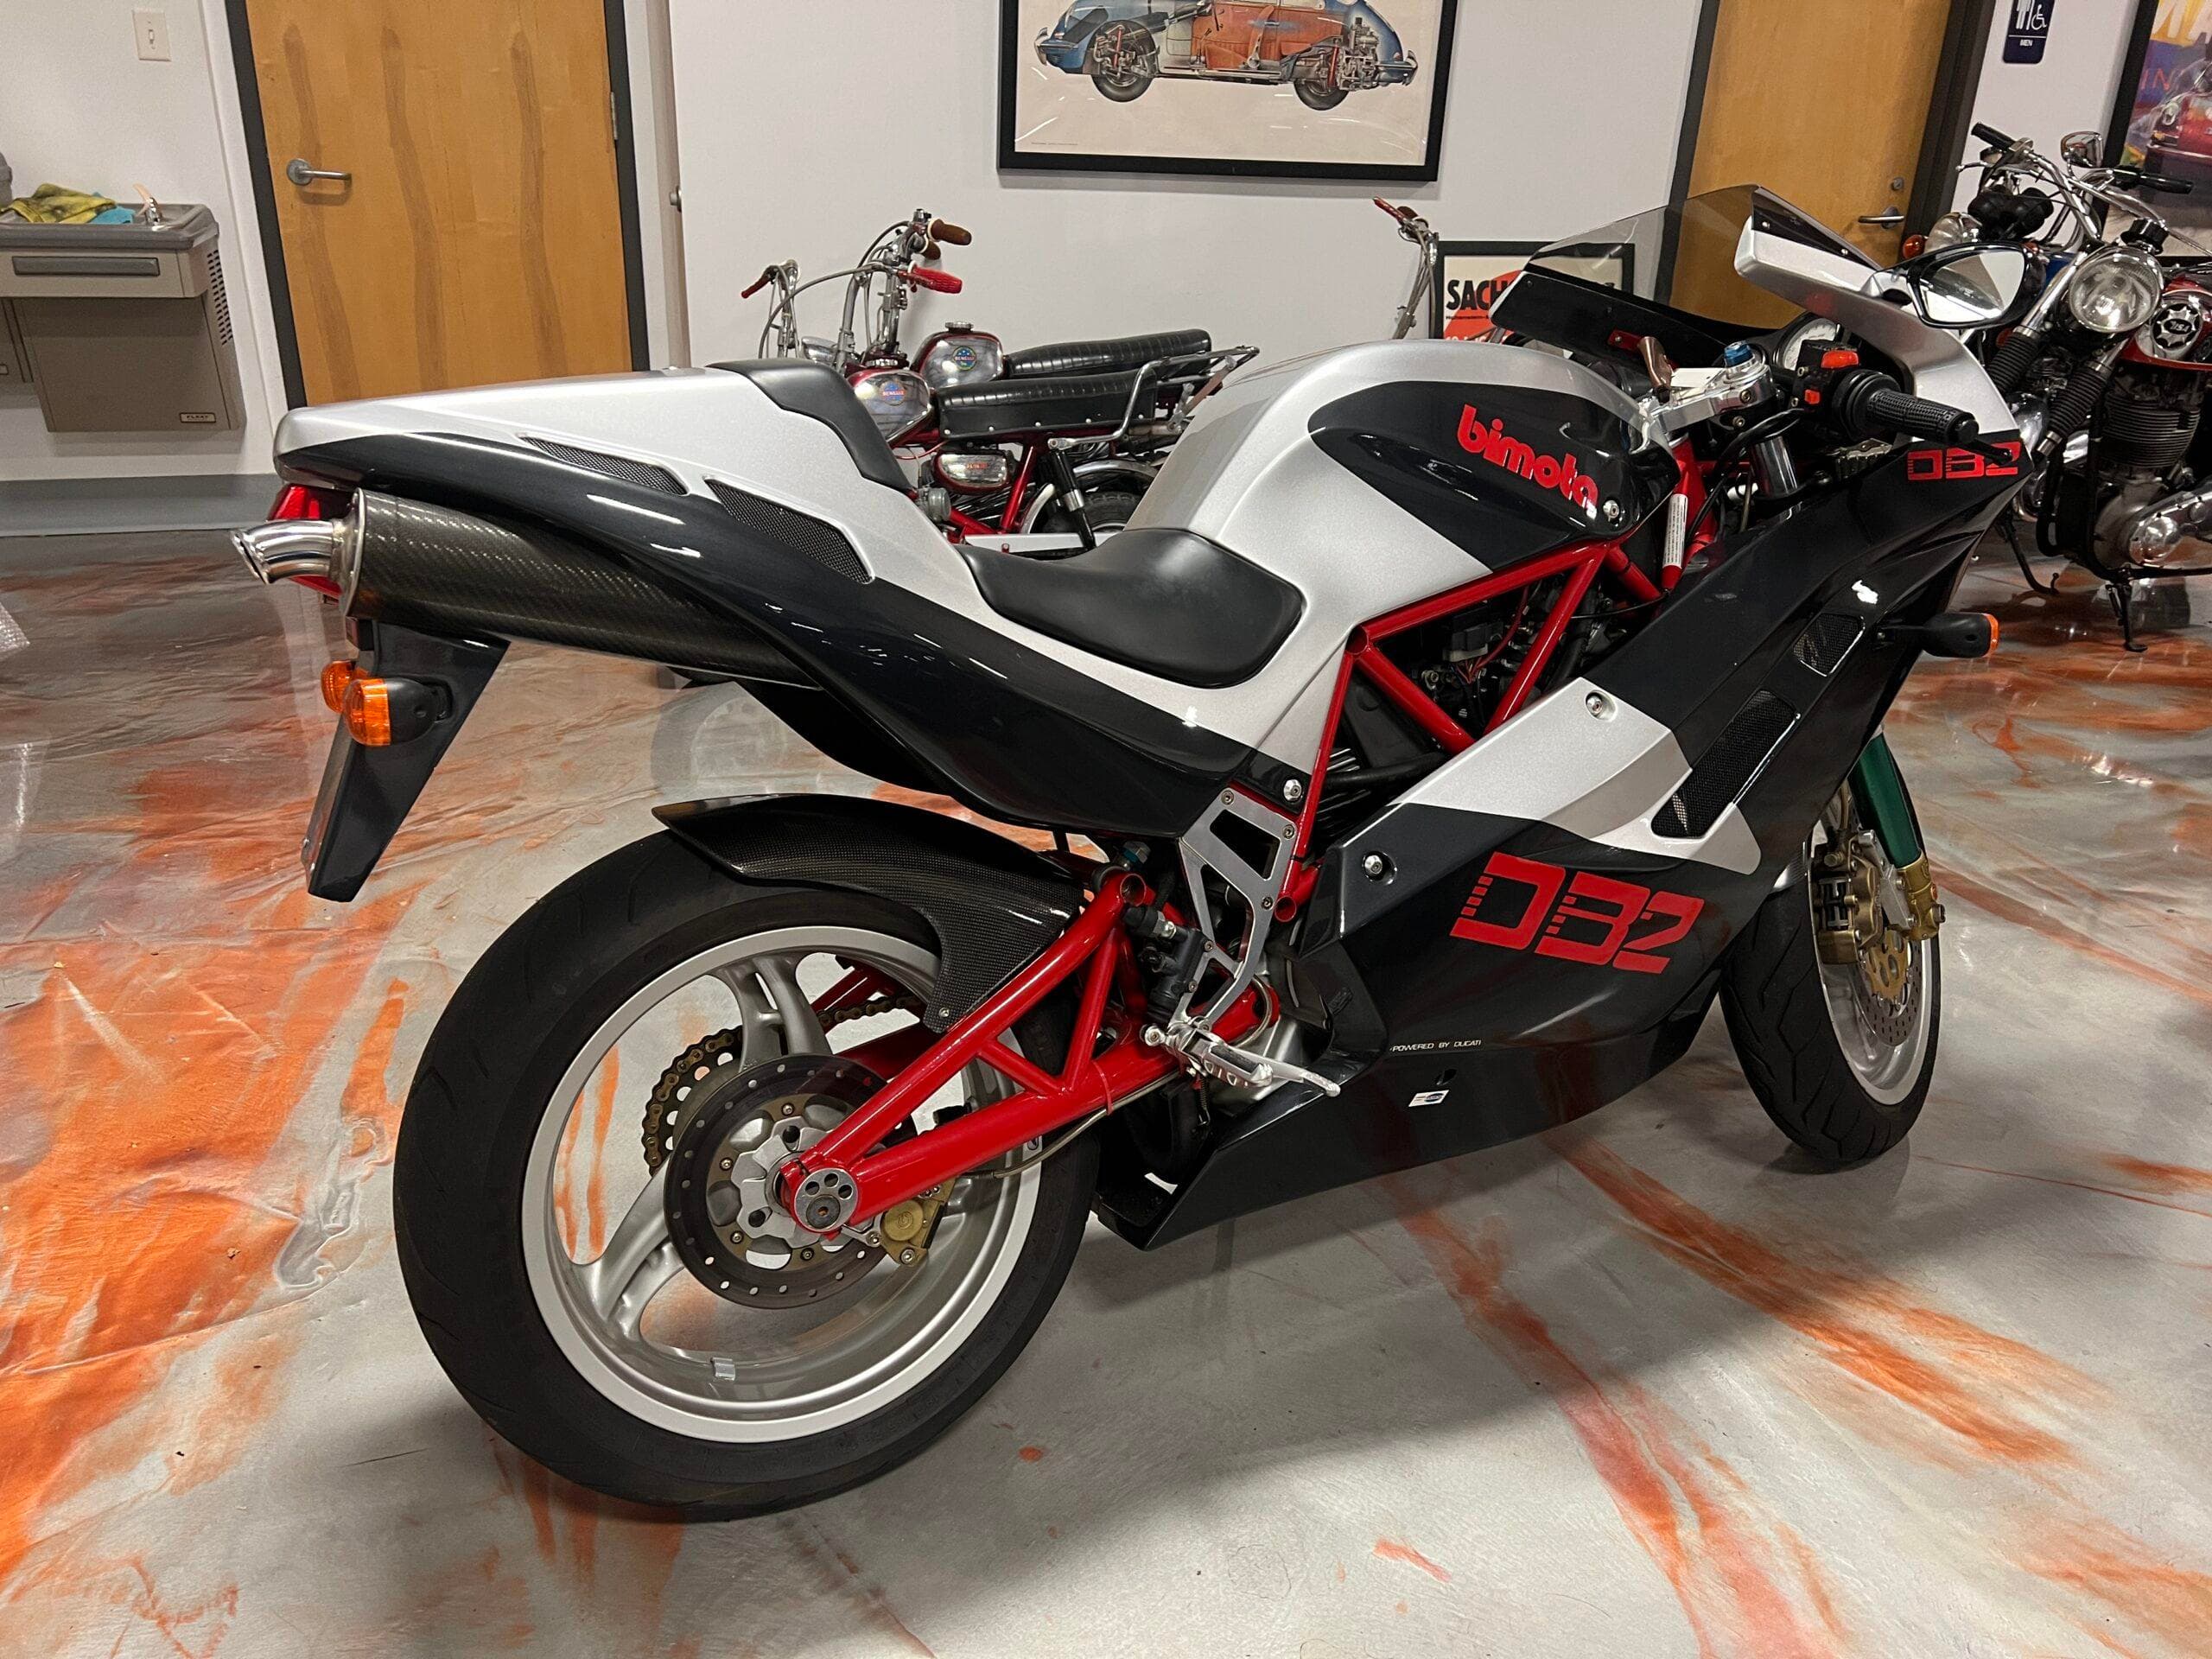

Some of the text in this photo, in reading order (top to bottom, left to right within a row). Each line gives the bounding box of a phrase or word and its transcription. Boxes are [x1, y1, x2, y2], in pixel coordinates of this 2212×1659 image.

[1446, 279, 1511, 310] SACH
[1457, 404, 1599, 520] bimota
[1449, 851, 1705, 974] DB2
[1391, 1043, 1434, 1052] POWERED
